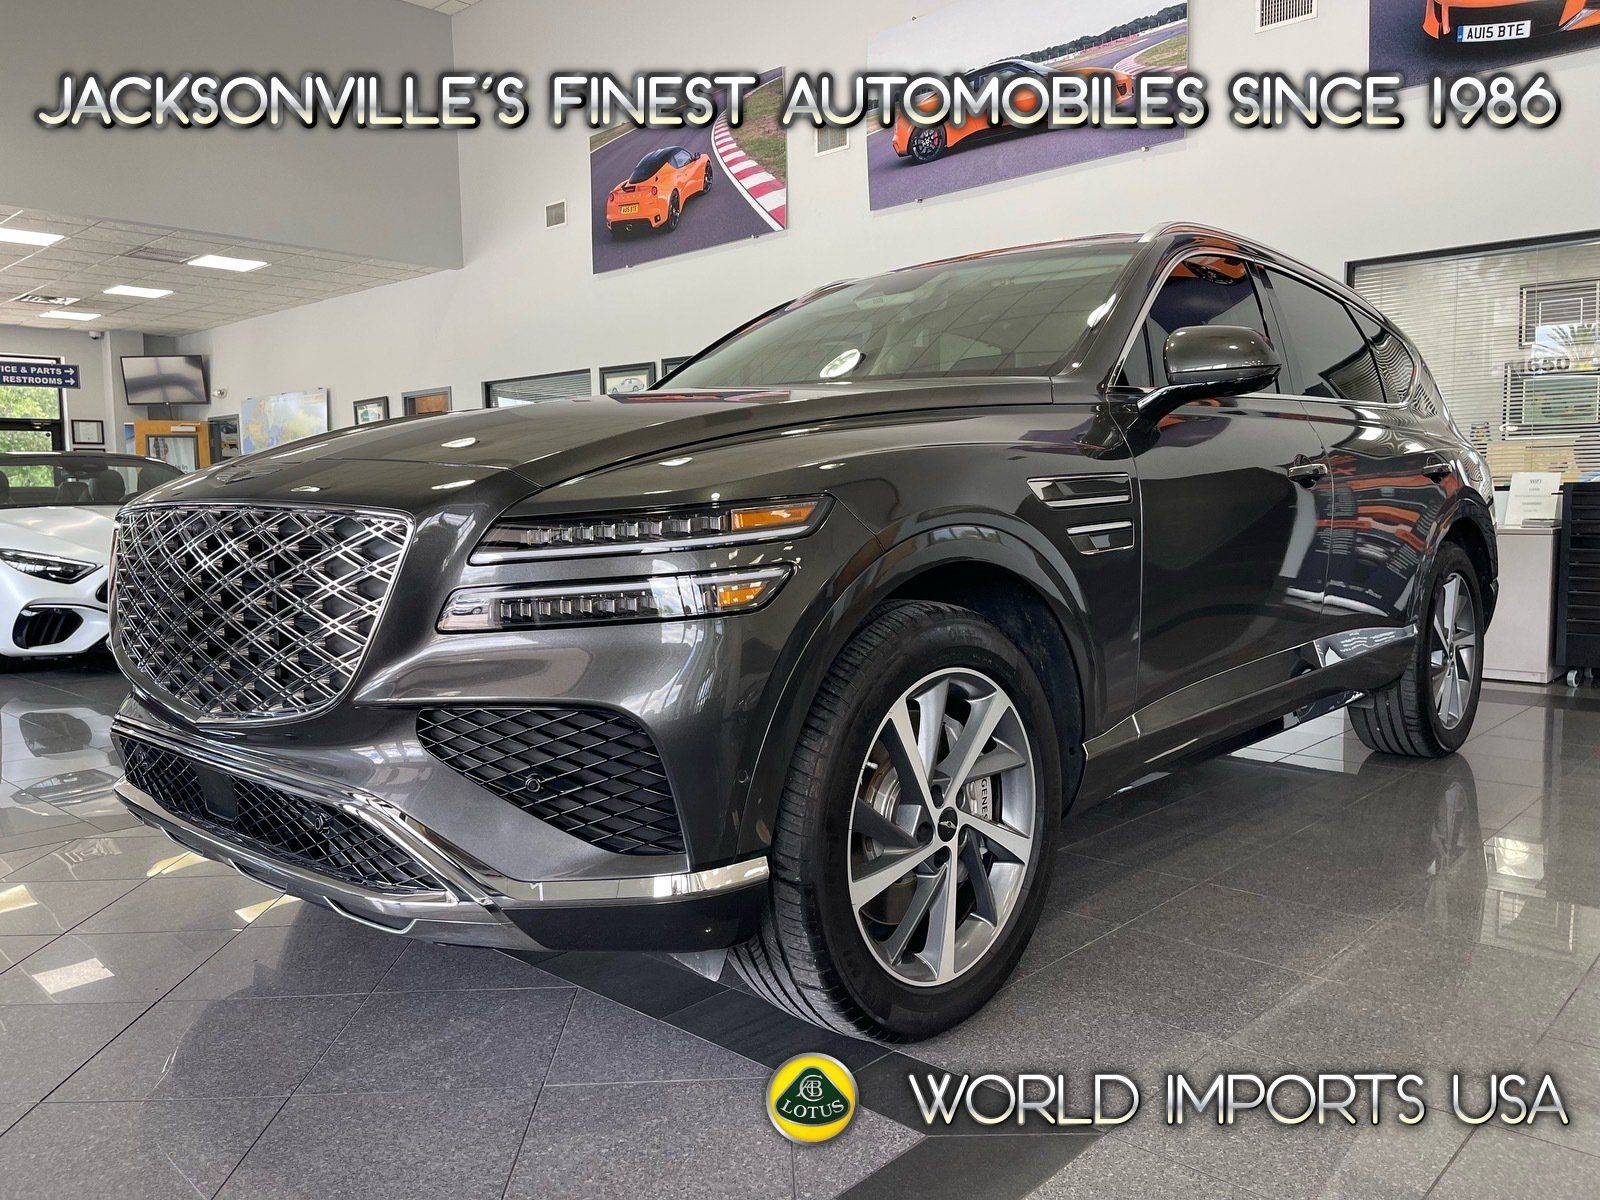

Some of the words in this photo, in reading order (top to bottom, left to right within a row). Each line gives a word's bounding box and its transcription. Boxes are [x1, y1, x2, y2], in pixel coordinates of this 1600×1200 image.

[1466, 26, 1494, 40] AU15
[1497, 23, 1525, 38] BTE
[0, 365, 18, 373] ICE
[30, 366, 62, 375] PARTS
[2, 375, 63, 385] RESTROOMS
